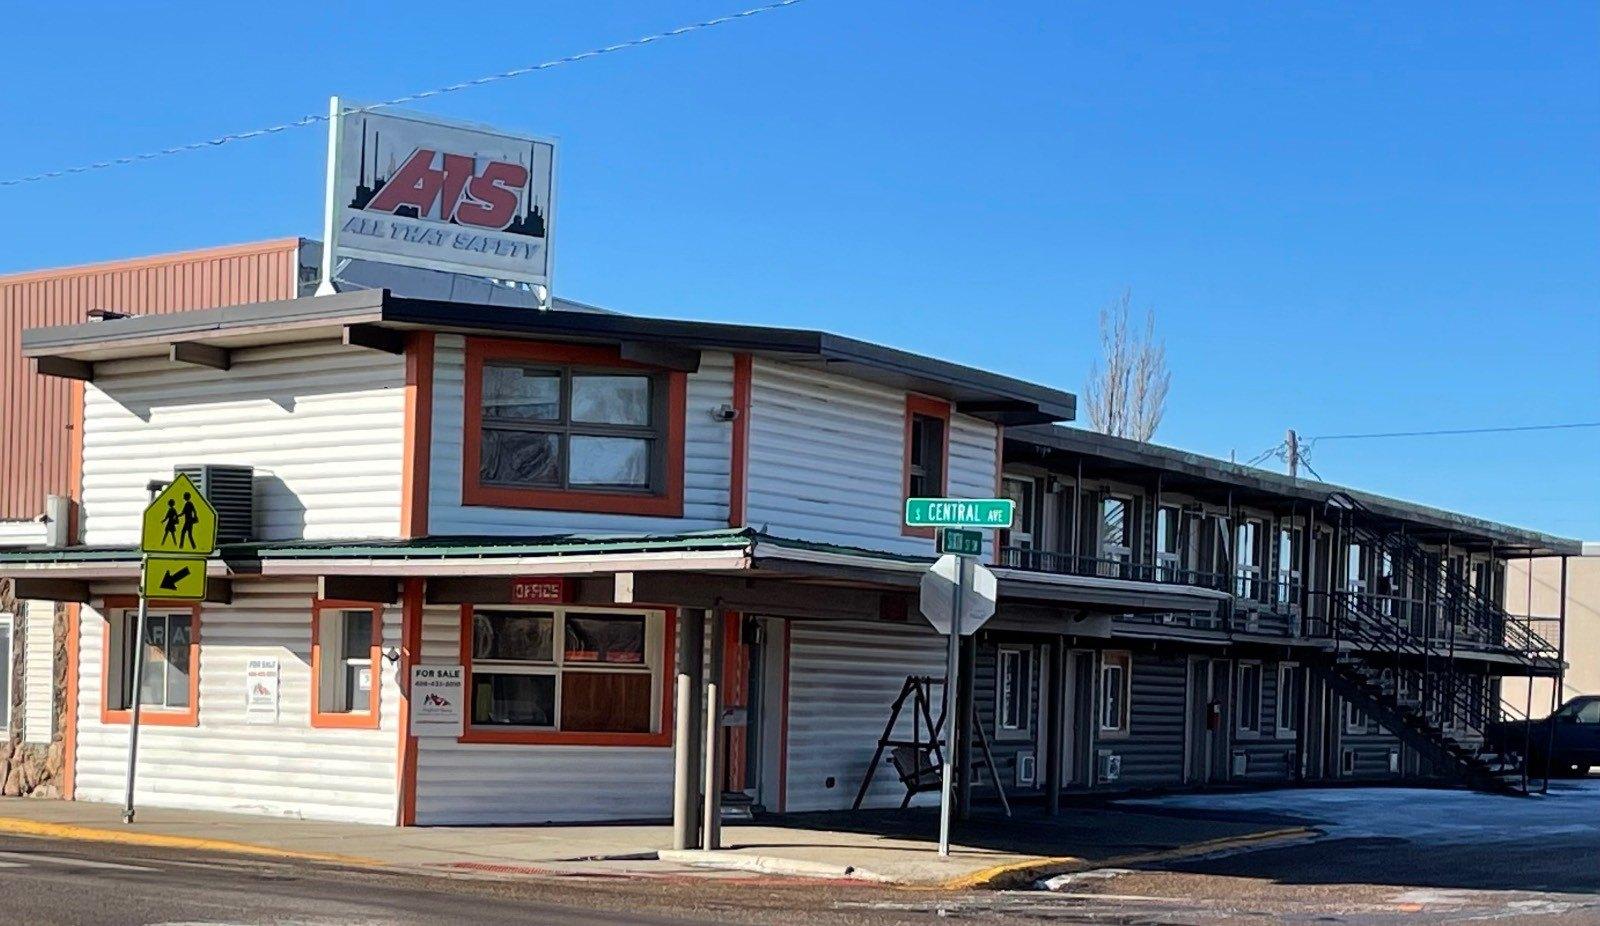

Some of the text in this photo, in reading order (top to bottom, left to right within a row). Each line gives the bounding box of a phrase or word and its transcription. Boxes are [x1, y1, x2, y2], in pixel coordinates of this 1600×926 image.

[364, 148, 529, 230] ATS
[342, 216, 540, 260] ALL THAT SAFETY
[915, 502, 1003, 523] S CENTRAL AVE
[516, 583, 560, 599] OFFICE
[416, 669, 460, 678] FOR SALE
